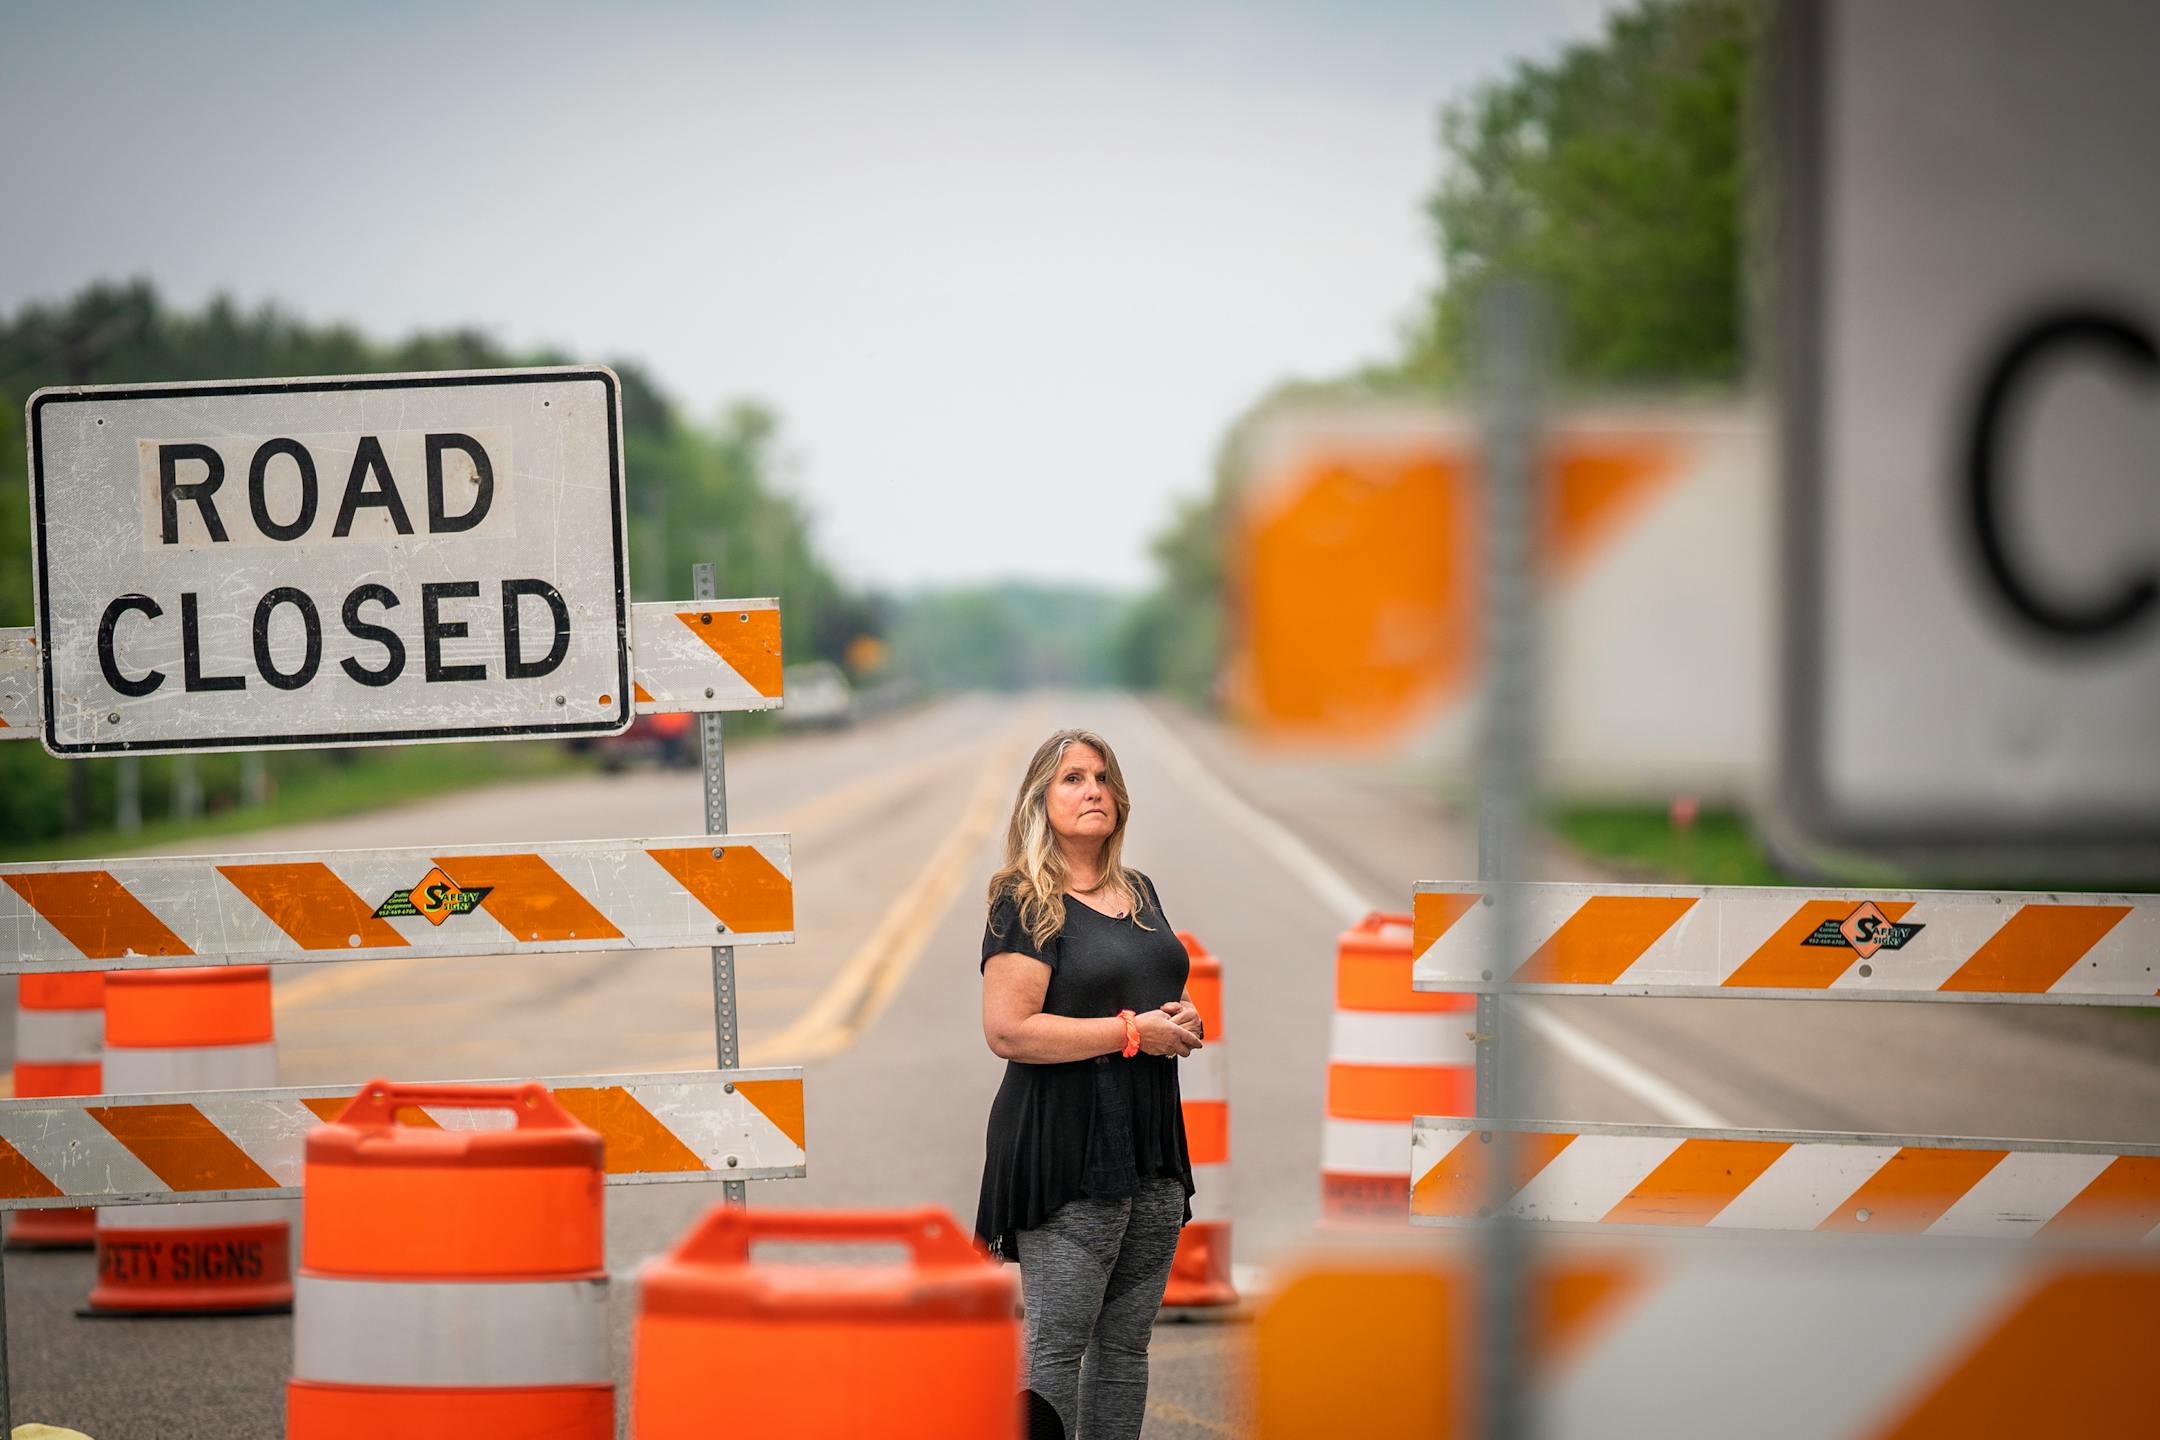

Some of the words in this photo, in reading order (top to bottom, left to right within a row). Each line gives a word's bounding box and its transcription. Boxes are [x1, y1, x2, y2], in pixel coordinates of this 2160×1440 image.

[159, 433, 494, 545] ROAD
[98, 579, 570, 698] CLOSED
[1873, 935, 1902, 946] SIGNS
[171, 1240, 263, 1281] SIGNS
